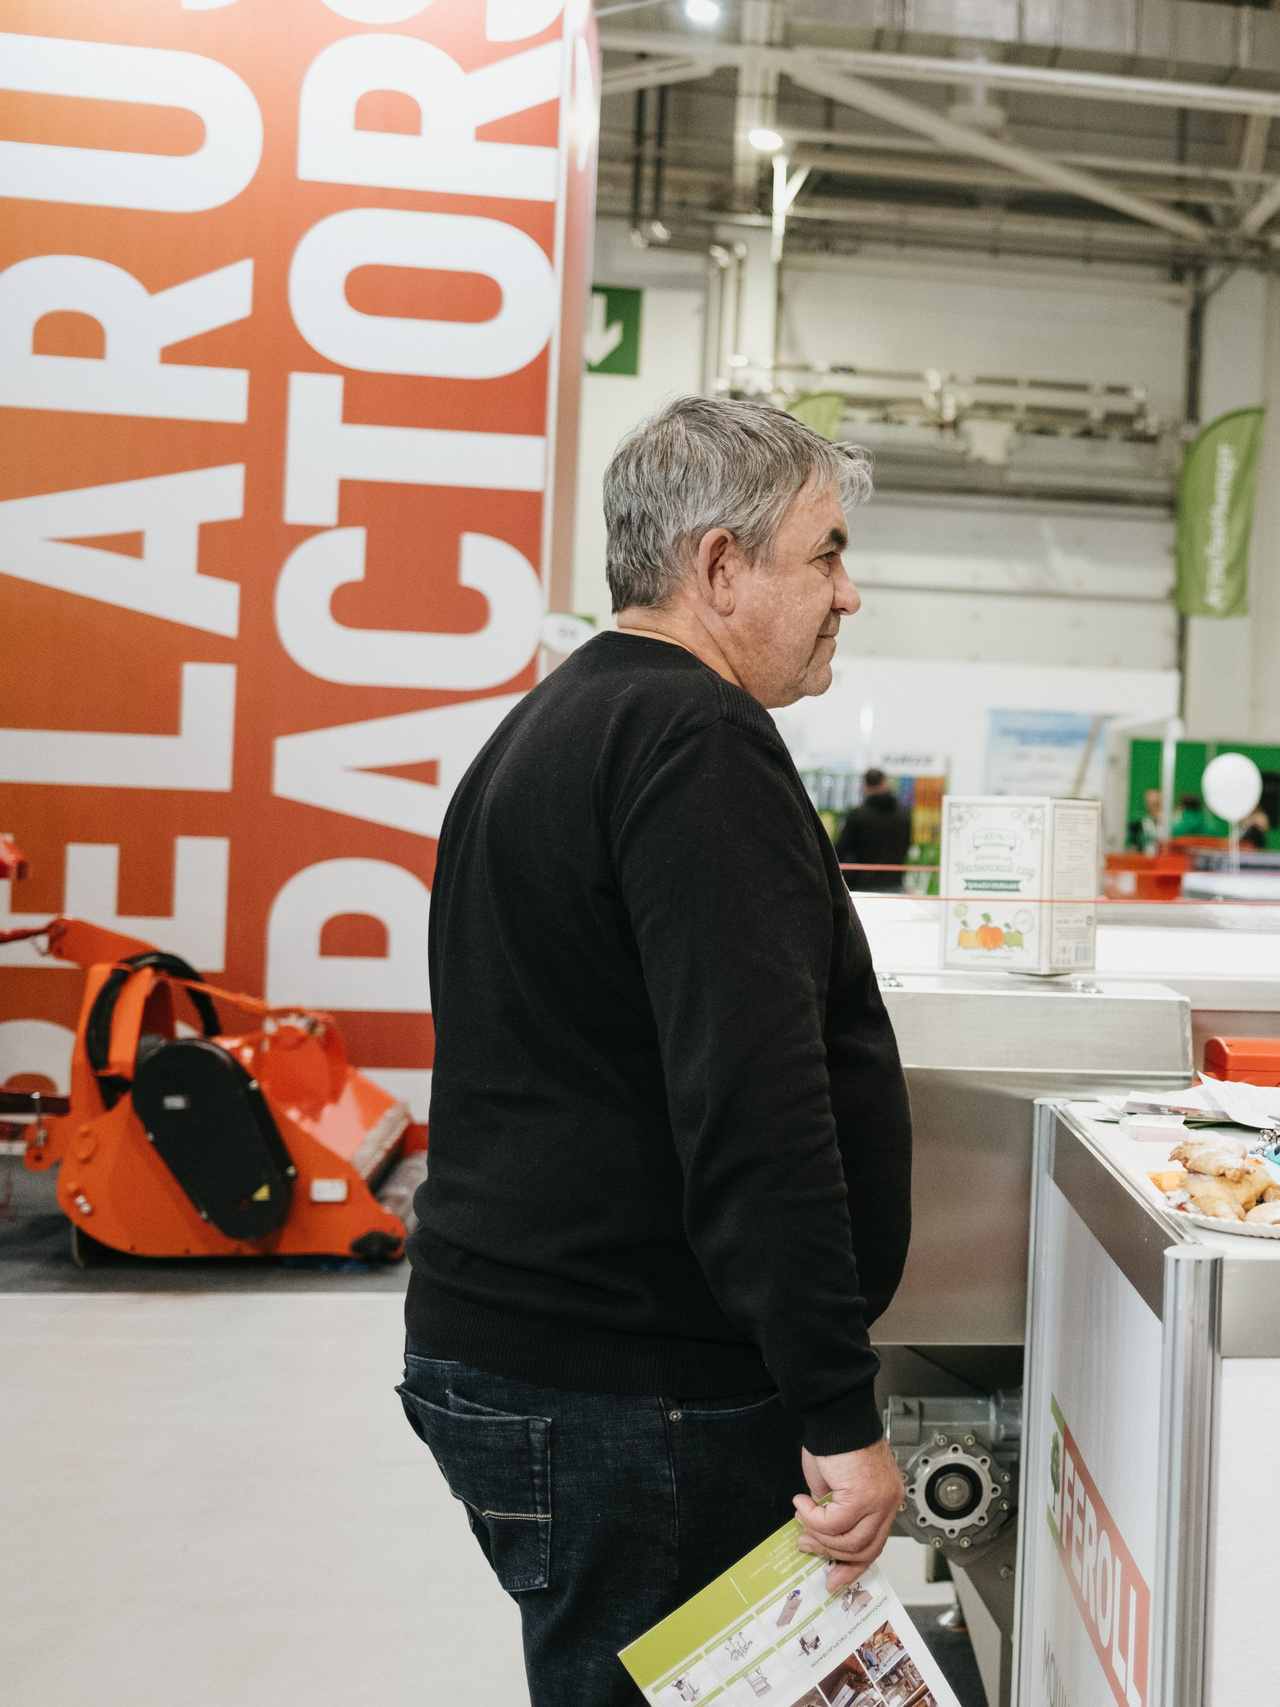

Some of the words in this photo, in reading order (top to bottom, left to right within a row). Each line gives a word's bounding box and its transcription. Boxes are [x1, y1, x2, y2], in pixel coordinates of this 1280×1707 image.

[0, 0, 264, 1154] ELARU
[811, 1634, 848, 1668] ОБОРУДОВАНИЕ
[848, 1595, 888, 1635] ДОПОЛНИТЕЛЬНОЕ
[1061, 1447, 1142, 1707] FEROLL
